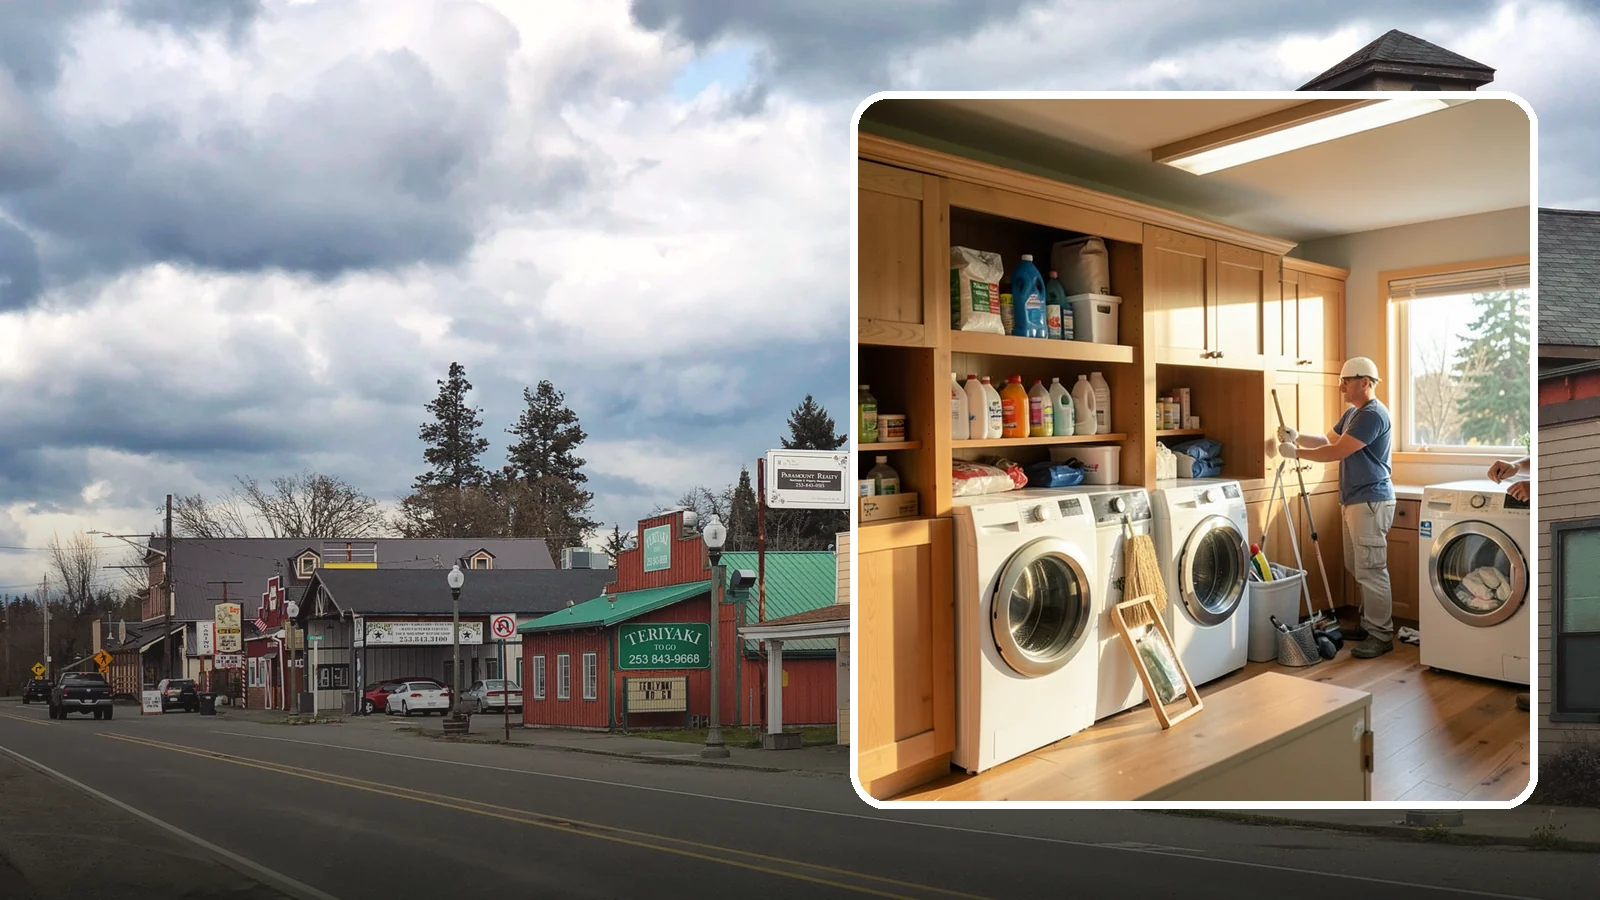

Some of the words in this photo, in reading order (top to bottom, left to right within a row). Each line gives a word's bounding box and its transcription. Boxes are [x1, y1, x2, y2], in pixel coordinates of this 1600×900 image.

[781, 471, 815, 479] PARAMOUNT
[817, 472, 839, 480] REALTY
[624, 627, 702, 646] TERIYAKI
[628, 654, 648, 664] 253
[652, 654, 700, 664] 843-9668
[638, 681, 672, 691] TERIYAKI
